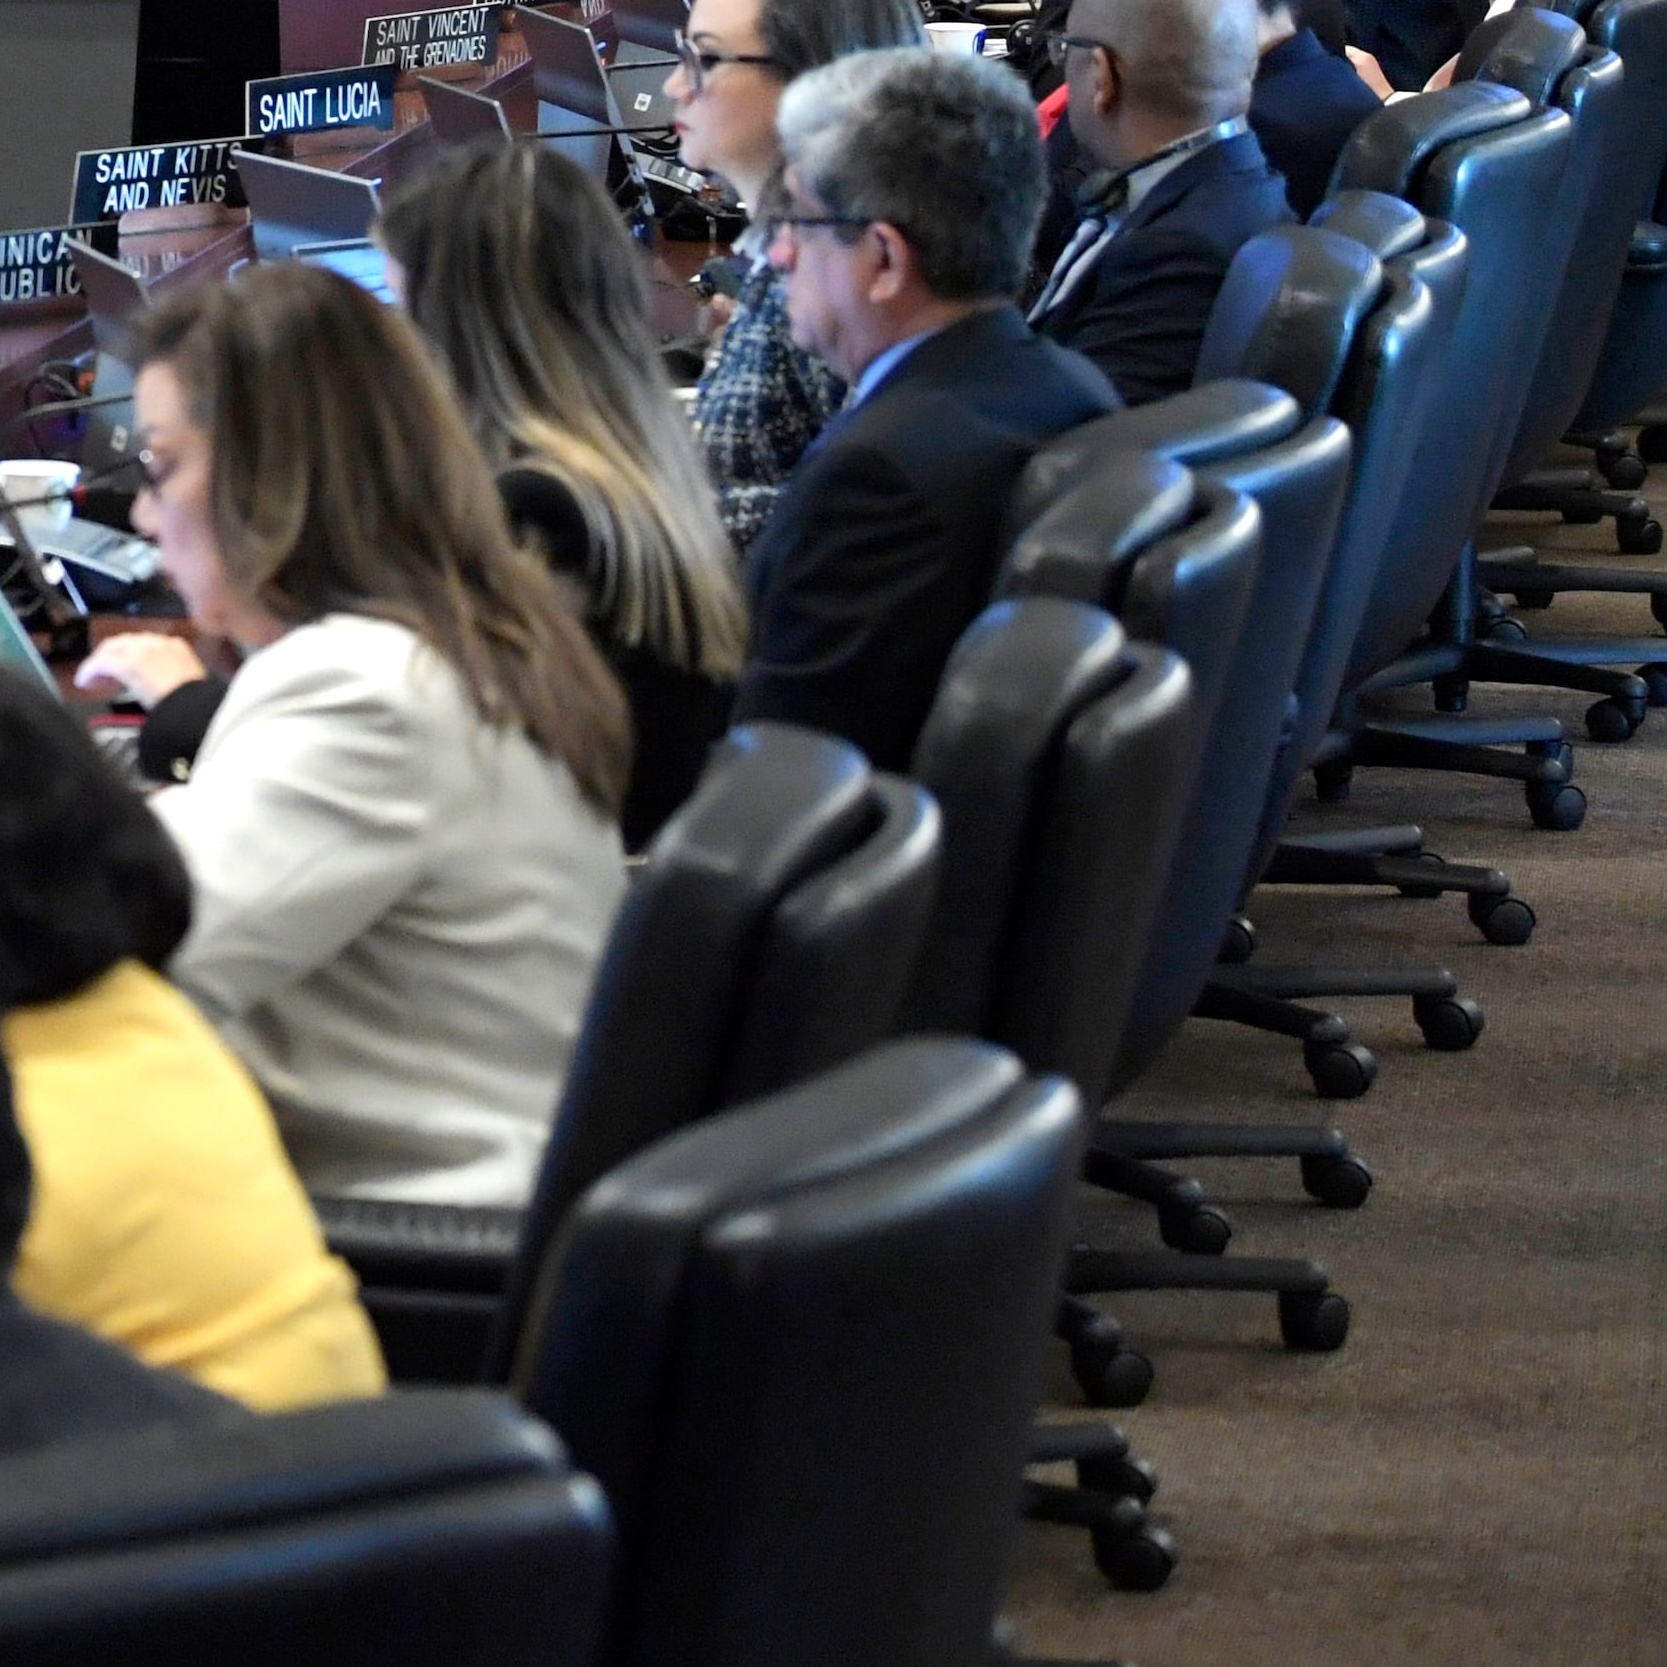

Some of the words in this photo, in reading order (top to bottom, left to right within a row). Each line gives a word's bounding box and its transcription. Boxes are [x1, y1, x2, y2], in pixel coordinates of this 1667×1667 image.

[376, 16, 421, 46] SAINT
[428, 7, 489, 38] VINCENT
[400, 44, 421, 70] THE
[423, 35, 486, 67] GRENADINES
[260, 88, 317, 132] SAINT
[326, 81, 381, 123] LUCIA
[95, 148, 164, 183] SAINT
[175, 142, 242, 174] KITTS
[103, 181, 149, 213] AND
[160, 174, 227, 207] NEVIS
